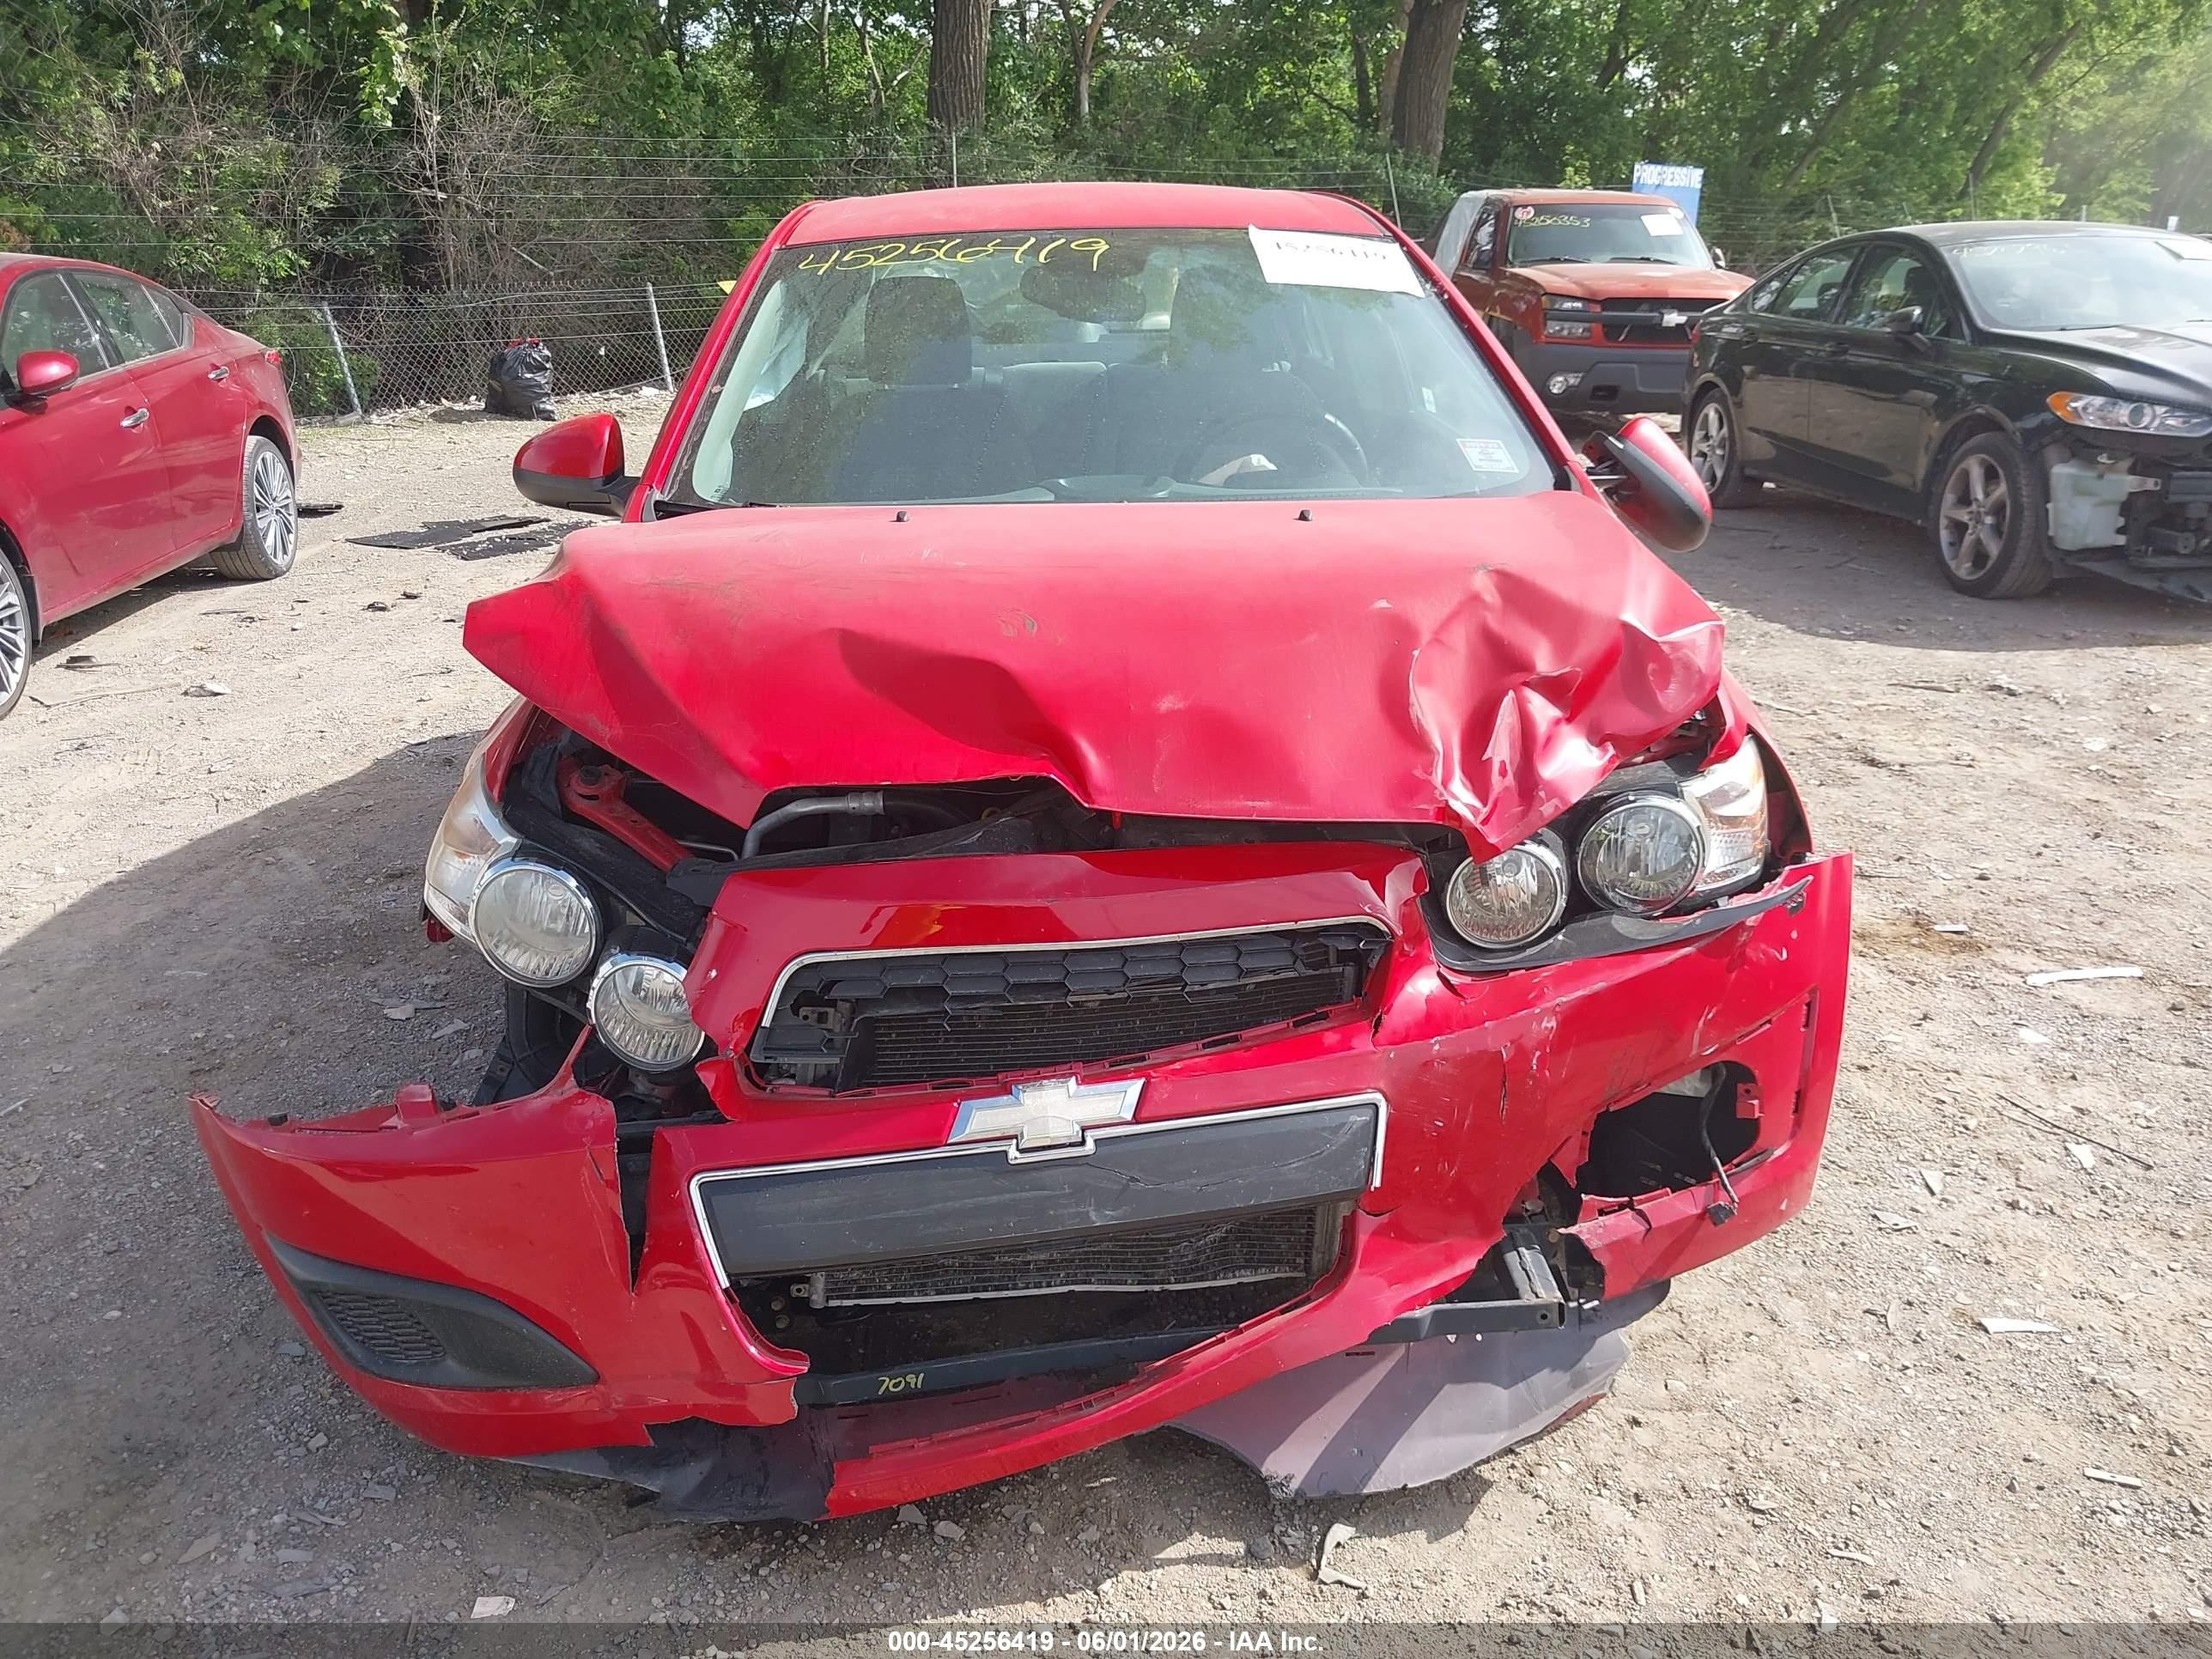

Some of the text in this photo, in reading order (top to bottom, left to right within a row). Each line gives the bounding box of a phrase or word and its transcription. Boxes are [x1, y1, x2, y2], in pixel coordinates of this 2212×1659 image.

[1633, 163, 1704, 189] PROGRESSIVE
[798, 236, 1110, 276] 45256419
[877, 1372, 925, 1395] 7091
